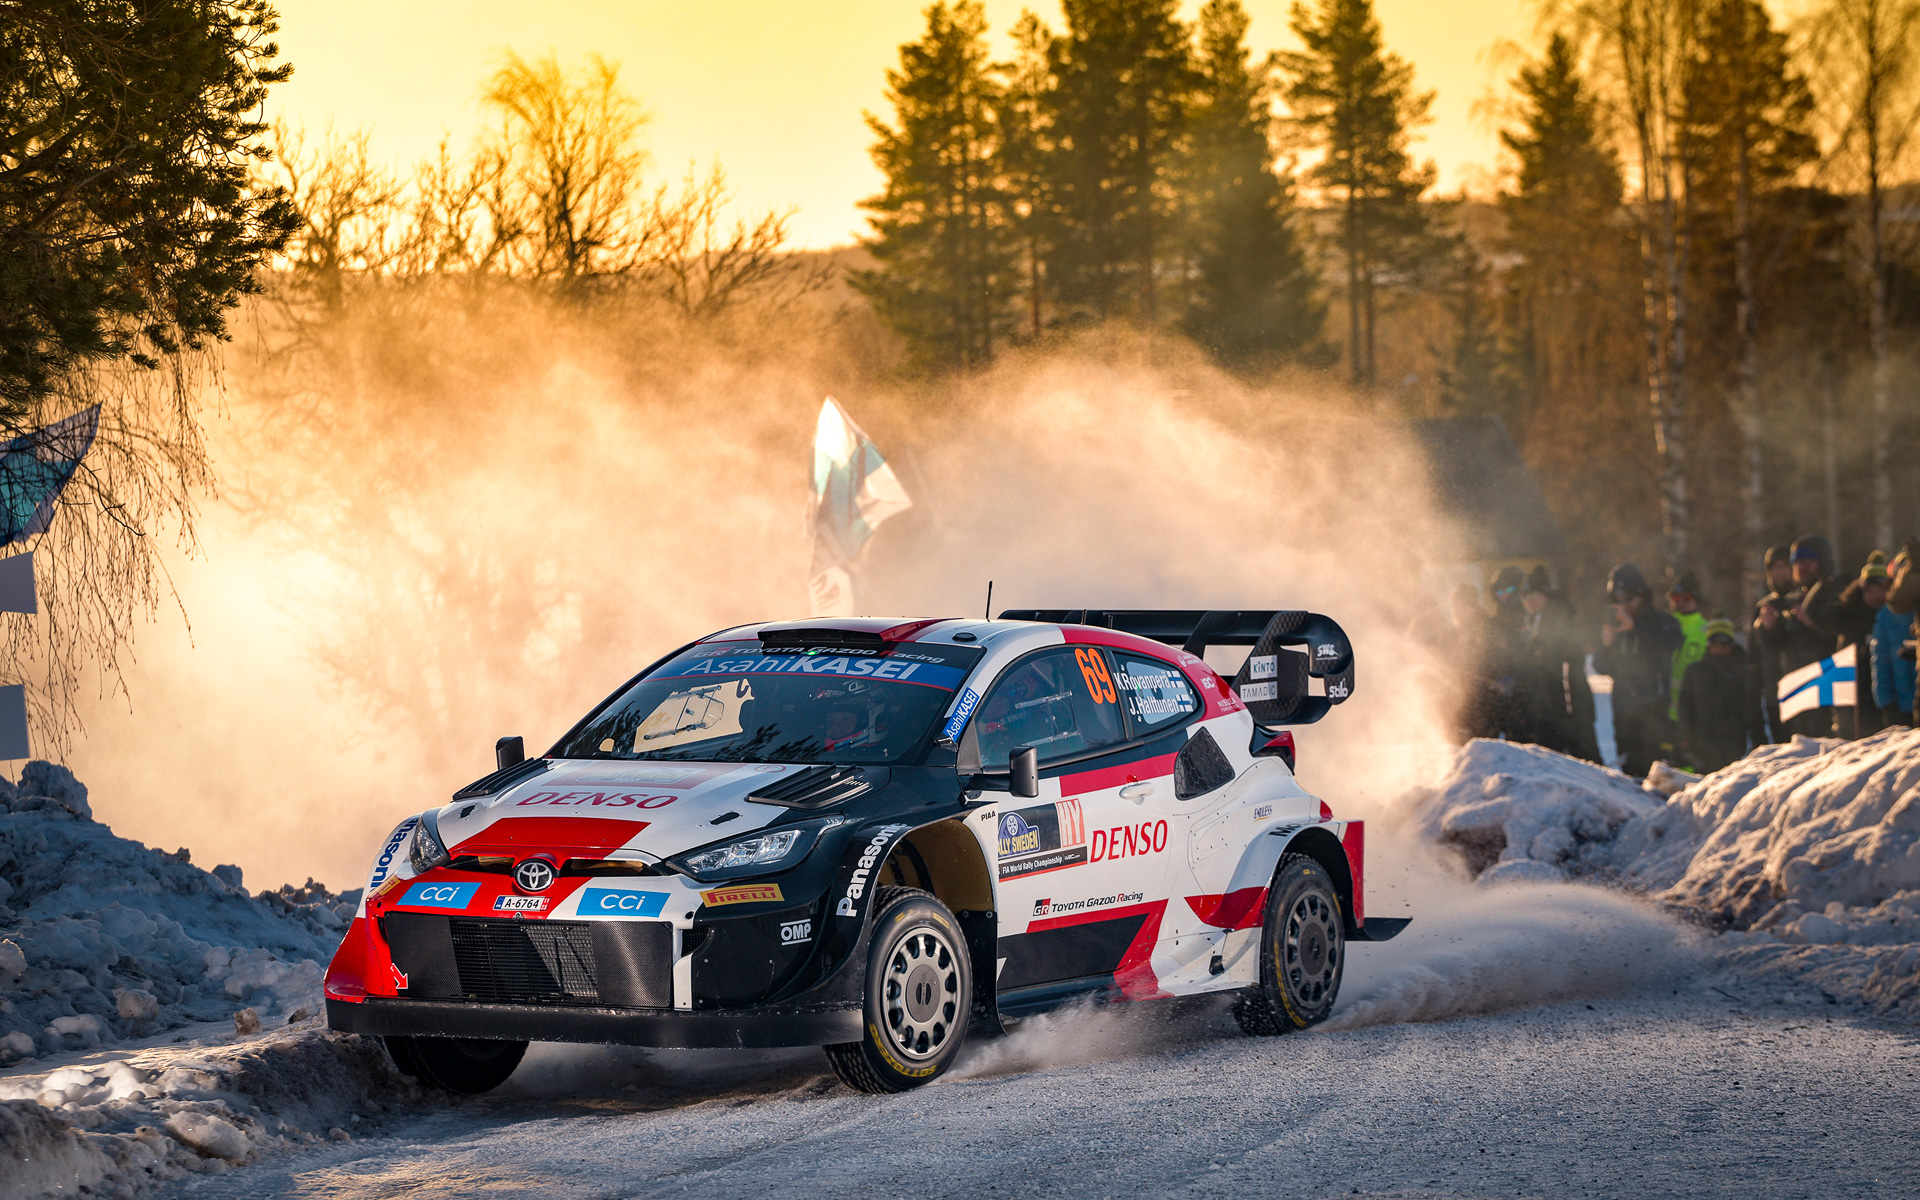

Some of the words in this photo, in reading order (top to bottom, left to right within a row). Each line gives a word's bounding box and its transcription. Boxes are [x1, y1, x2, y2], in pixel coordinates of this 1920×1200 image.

[734, 647, 802, 657] TOYOTA
[879, 650, 946, 664] Racing
[681, 656, 922, 680] AsahiKASEI
[1075, 648, 1116, 704] 69
[1242, 686, 1276, 698] TAMADIC
[946, 690, 978, 740] AsahiKASEI
[515, 792, 679, 809] DENSO
[981, 810, 996, 821] PIAA
[1254, 805, 1272, 819] ENDLESS
[997, 838, 1011, 855] ALLY
[1012, 830, 1039, 853] SWEDEN
[1090, 819, 1168, 863] DENSO
[370, 818, 418, 892] anasoni
[1002, 864, 1010, 874] FIA
[1010, 863, 1022, 872] World
[1023, 861, 1034, 870] Rally
[1034, 855, 1063, 868] Championship
[836, 823, 911, 917] Panasonic
[505, 898, 540, 909] A-6764
[706, 887, 777, 903] PIRELLI
[1033, 905, 1049, 916] GR
[1052, 901, 1085, 913] TOYOTA
[1086, 898, 1116, 907] GAZOO
[1117, 892, 1143, 903] Racing
[781, 922, 812, 941] OMP
